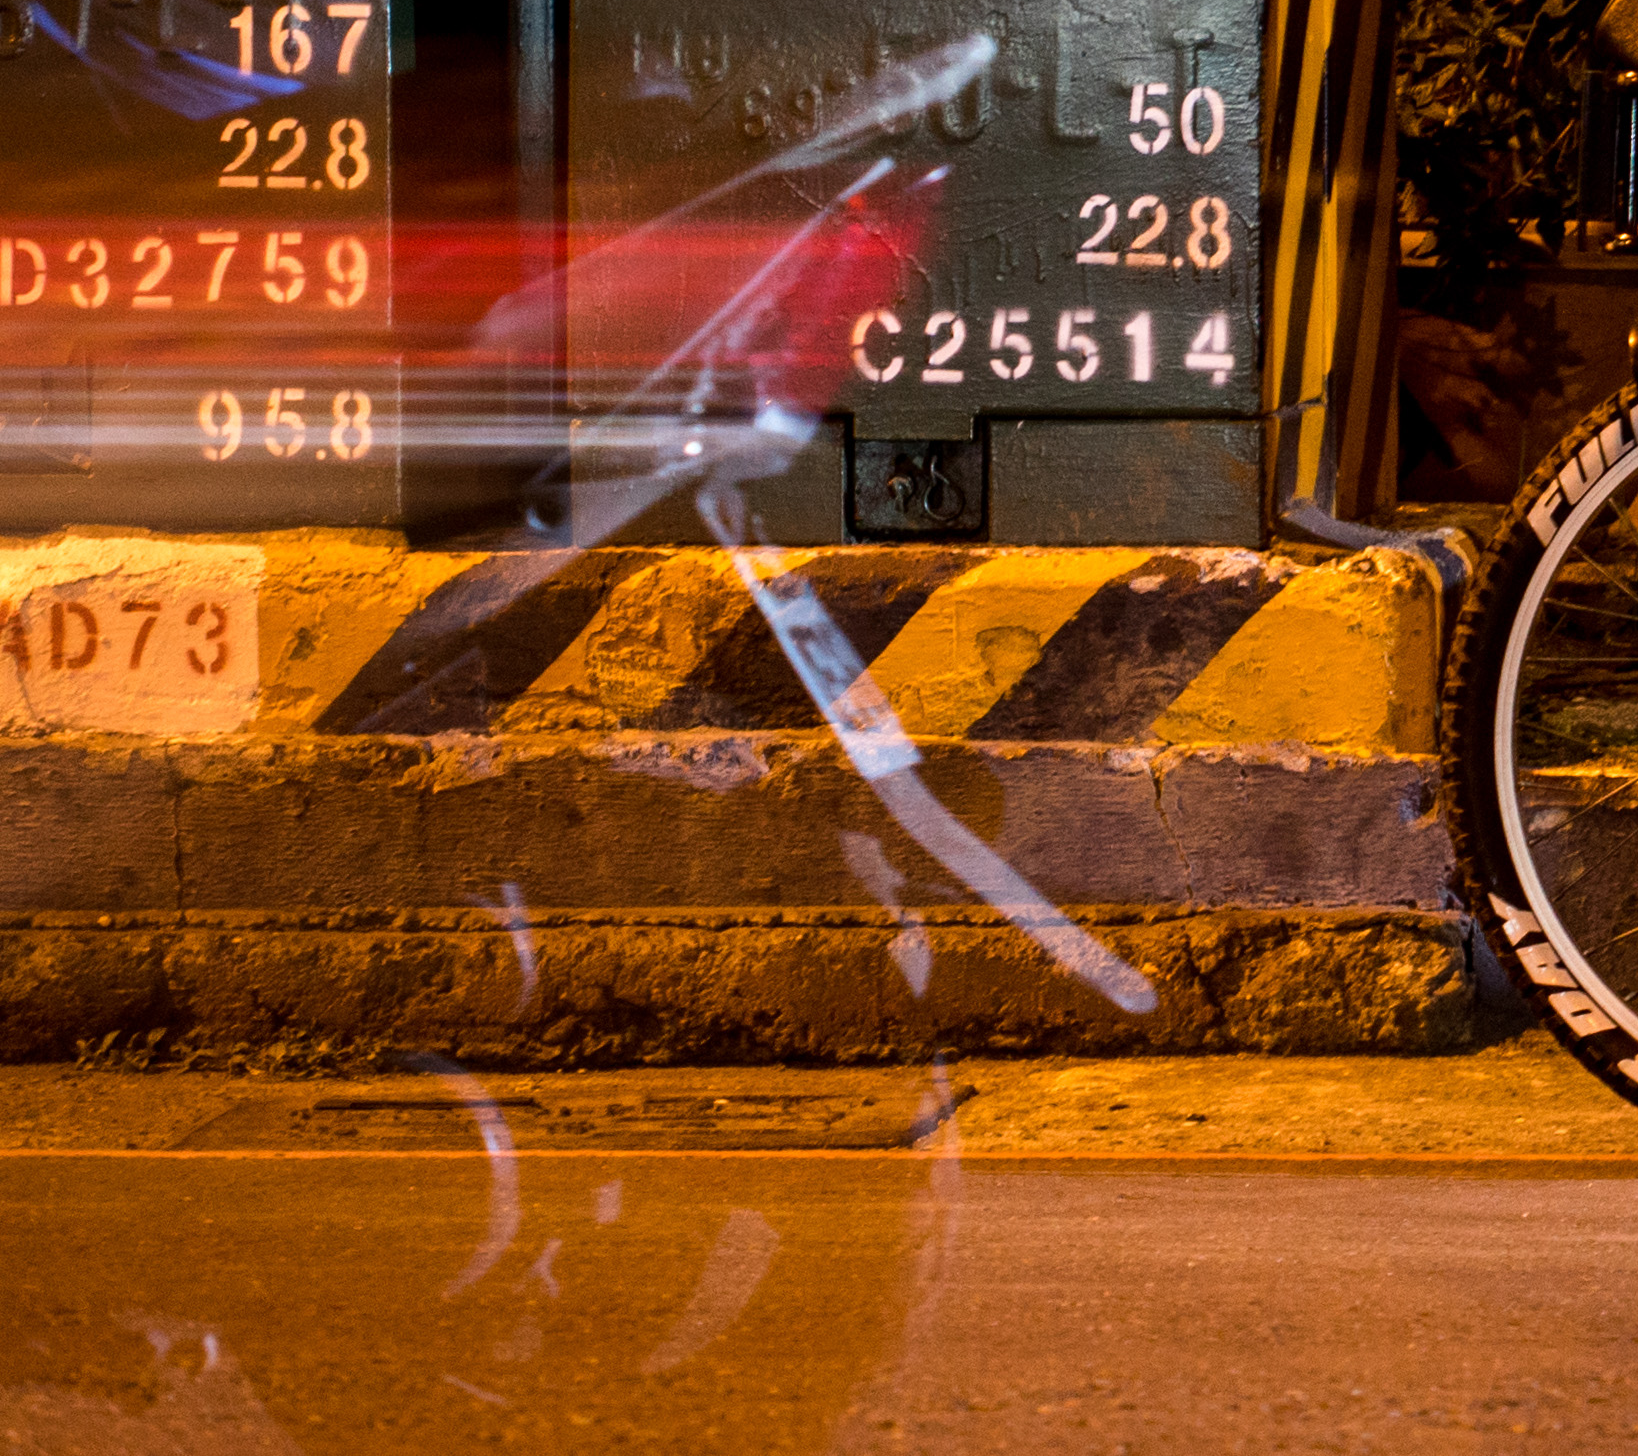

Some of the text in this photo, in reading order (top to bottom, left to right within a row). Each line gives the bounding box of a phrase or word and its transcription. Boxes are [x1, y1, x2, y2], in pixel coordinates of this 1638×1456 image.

[229, 3, 372, 75] 167
[218, 118, 371, 189] 22.8
[1129, 82, 1226, 156] 50
[1076, 194, 1233, 269] 22.8
[0, 232, 369, 310] D32759
[851, 306, 1236, 385] C25514
[199, 386, 373, 462] 95.8
[1487, 891, 1618, 1038] DAY
